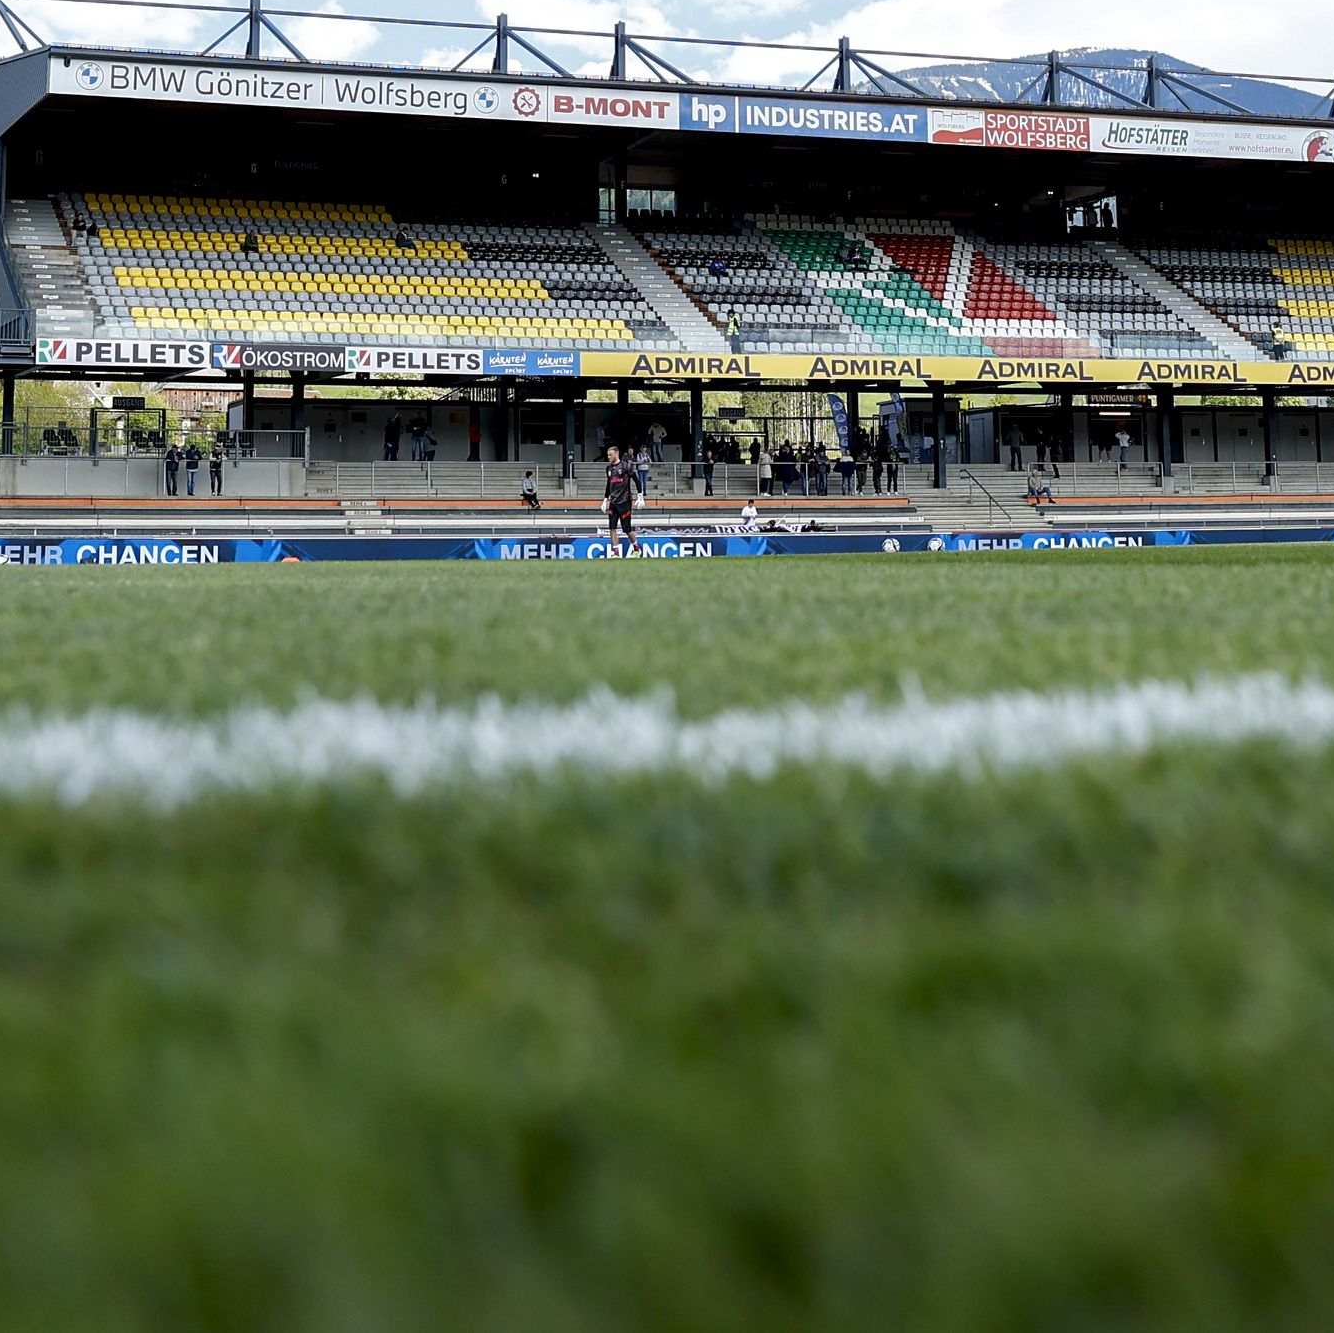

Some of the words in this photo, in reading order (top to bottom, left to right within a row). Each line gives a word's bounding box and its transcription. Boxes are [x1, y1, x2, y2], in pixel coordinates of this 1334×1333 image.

[110, 65, 186, 93] BMW
[195, 70, 313, 100] Gönitzer
[334, 78, 467, 115] Wolfsberg
[554, 95, 670, 118] B-MONT
[692, 97, 726, 128] hp
[746, 105, 918, 134] INDUSTRIES.AT
[987, 114, 1087, 133] SPORTSTADT
[987, 130, 1088, 149] WOLFSBERG
[1228, 144, 1294, 155] www.hofstaetter.eu
[76, 343, 205, 364] PELLETS
[242, 347, 344, 368] ÖKOSTROM
[377, 352, 481, 370] PELLETS
[631, 354, 761, 377] ADMIRAL
[809, 357, 932, 378] ADMIRAL
[977, 360, 1094, 381] ADMIRAL
[1137, 361, 1247, 382] ADMIRAL
[1091, 394, 1134, 403] PUNTIGAMER
[76, 544, 219, 564] CHANCEN
[500, 544, 575, 559] MEHR
[958, 538, 1023, 550] MEHR
[1033, 537, 1143, 549] CHANCEN
